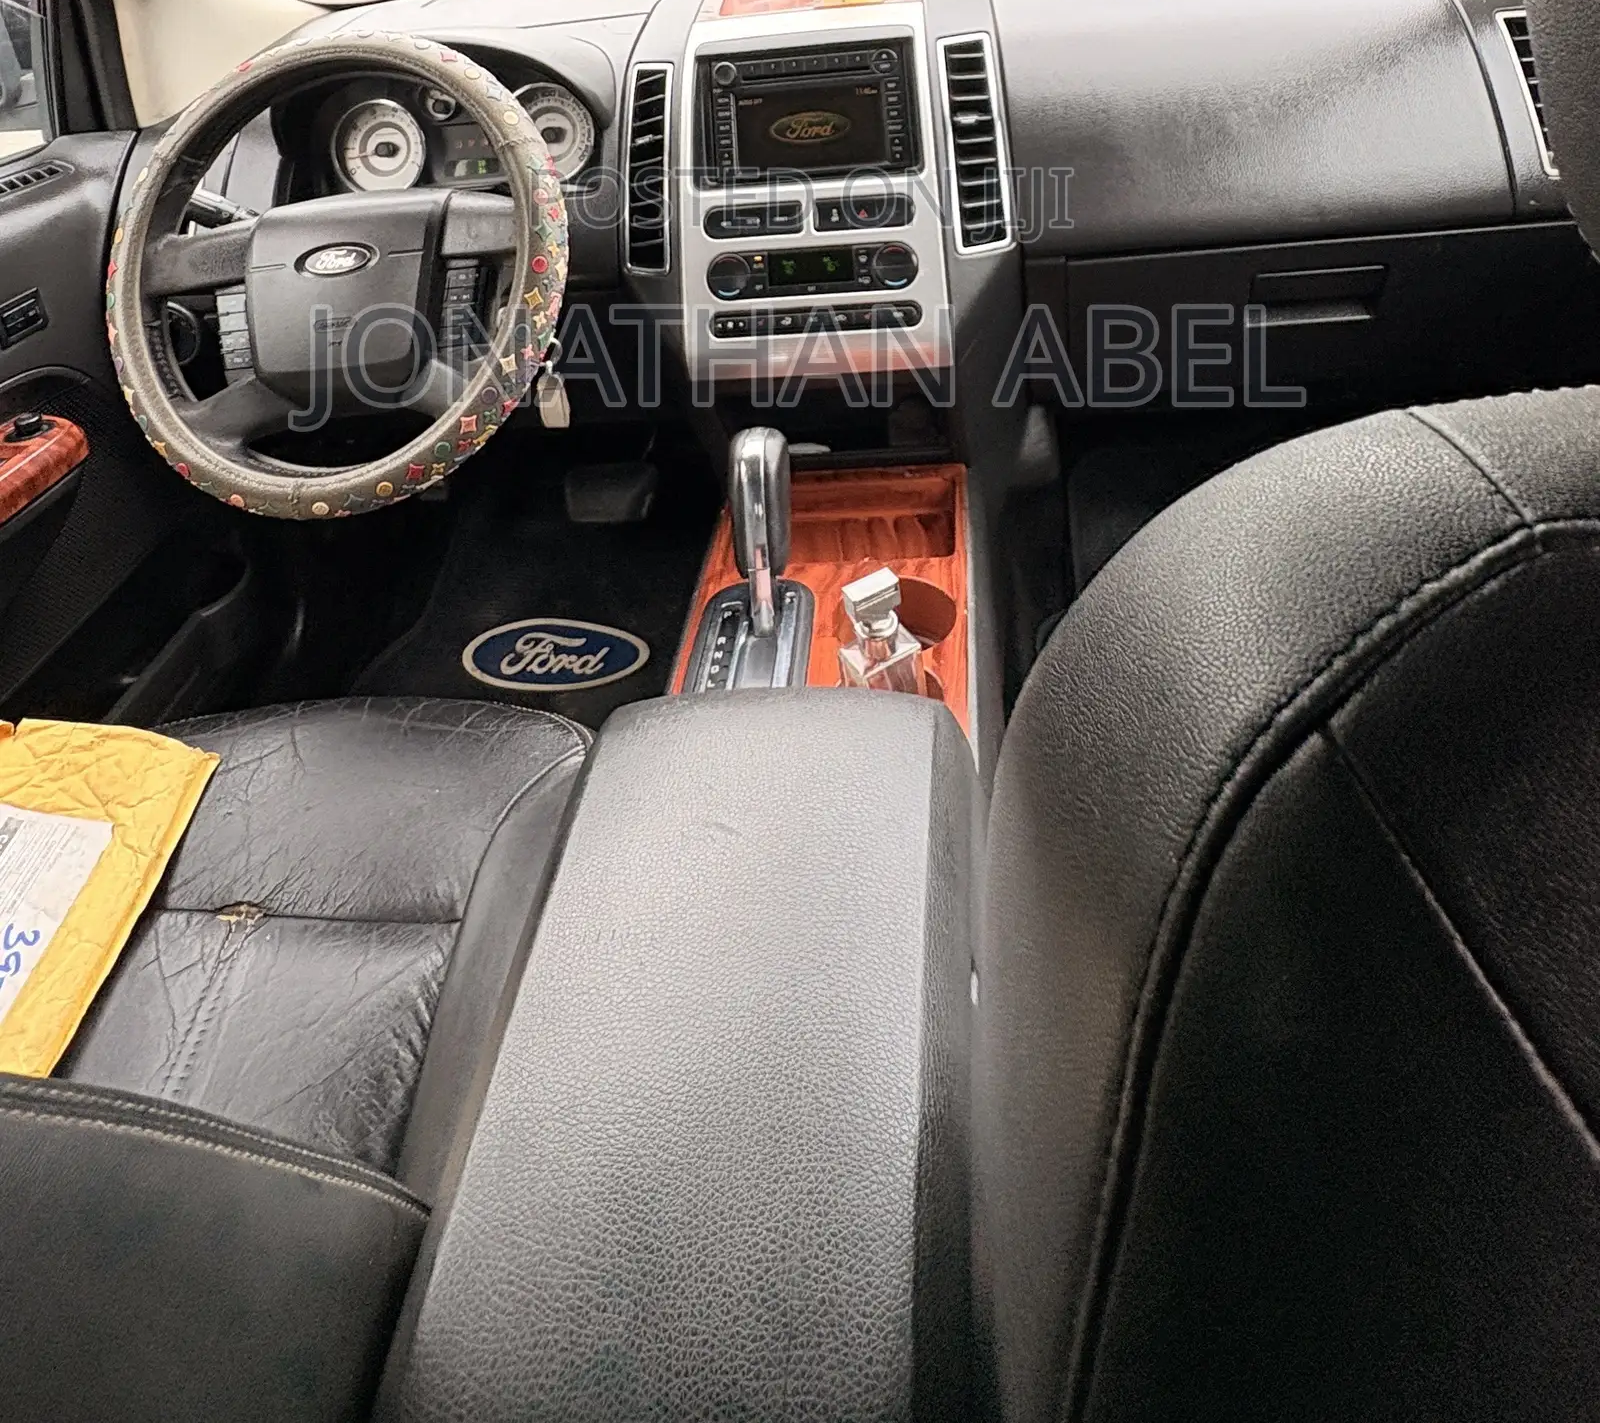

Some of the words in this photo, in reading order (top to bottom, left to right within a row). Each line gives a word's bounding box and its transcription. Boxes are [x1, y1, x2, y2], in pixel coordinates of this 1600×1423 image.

[786, 115, 835, 139] Ford
[315, 249, 357, 270] Ford
[500, 631, 611, 675] Ford
[714, 650, 723, 659] N
[706, 679, 715, 688] L
